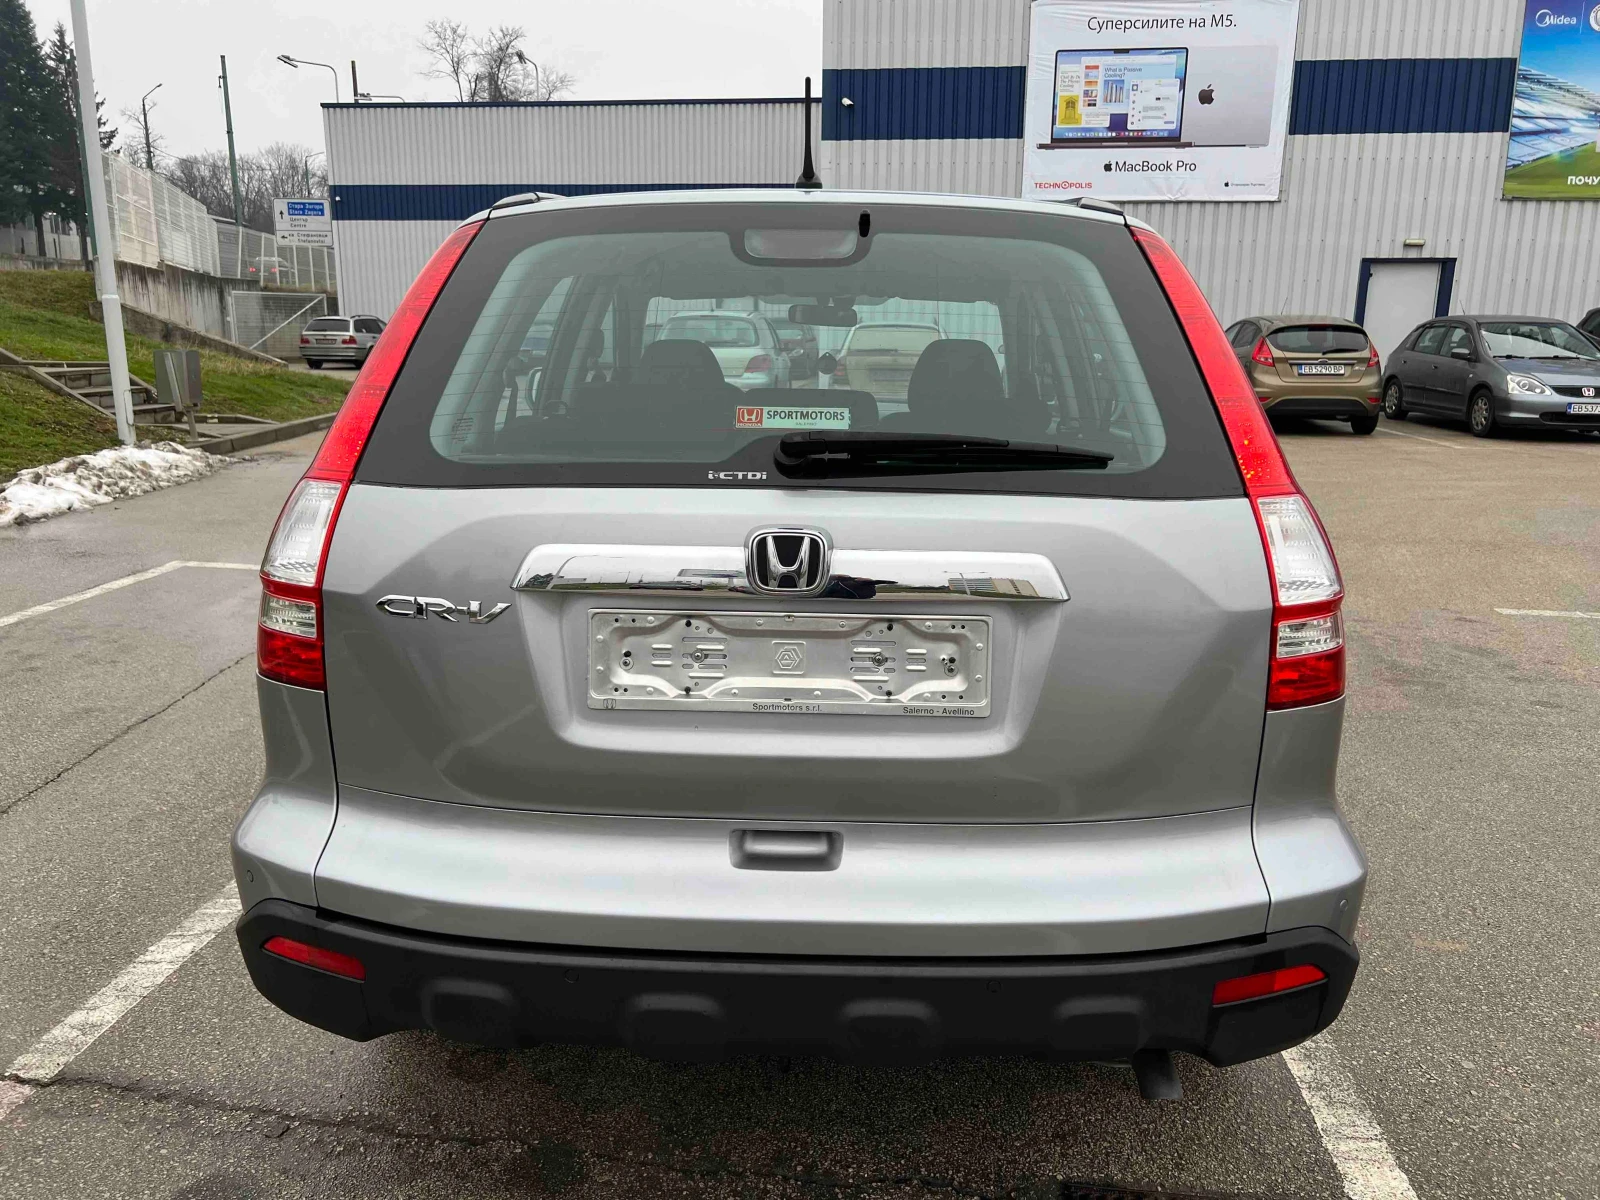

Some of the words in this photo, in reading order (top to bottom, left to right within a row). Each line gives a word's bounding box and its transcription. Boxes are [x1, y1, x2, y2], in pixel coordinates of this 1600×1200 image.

[1087, 16, 1185, 34] Суперсилите
[1188, 17, 1206, 28] на
[1210, 14, 1237, 28] M5.
[1538, 11, 1577, 27] Midea
[1114, 160, 1173, 173] MacBook
[1176, 159, 1197, 172] Pro
[1034, 180, 1093, 190] TECHNOPOLIS
[766, 410, 845, 421] SPORTMOTORS
[375, 594, 513, 624] CR-V
[752, 702, 803, 713] Sportmotors
[805, 703, 823, 712] s.r.l.
[902, 706, 935, 716] Salerno
[941, 707, 975, 717] Avellino
